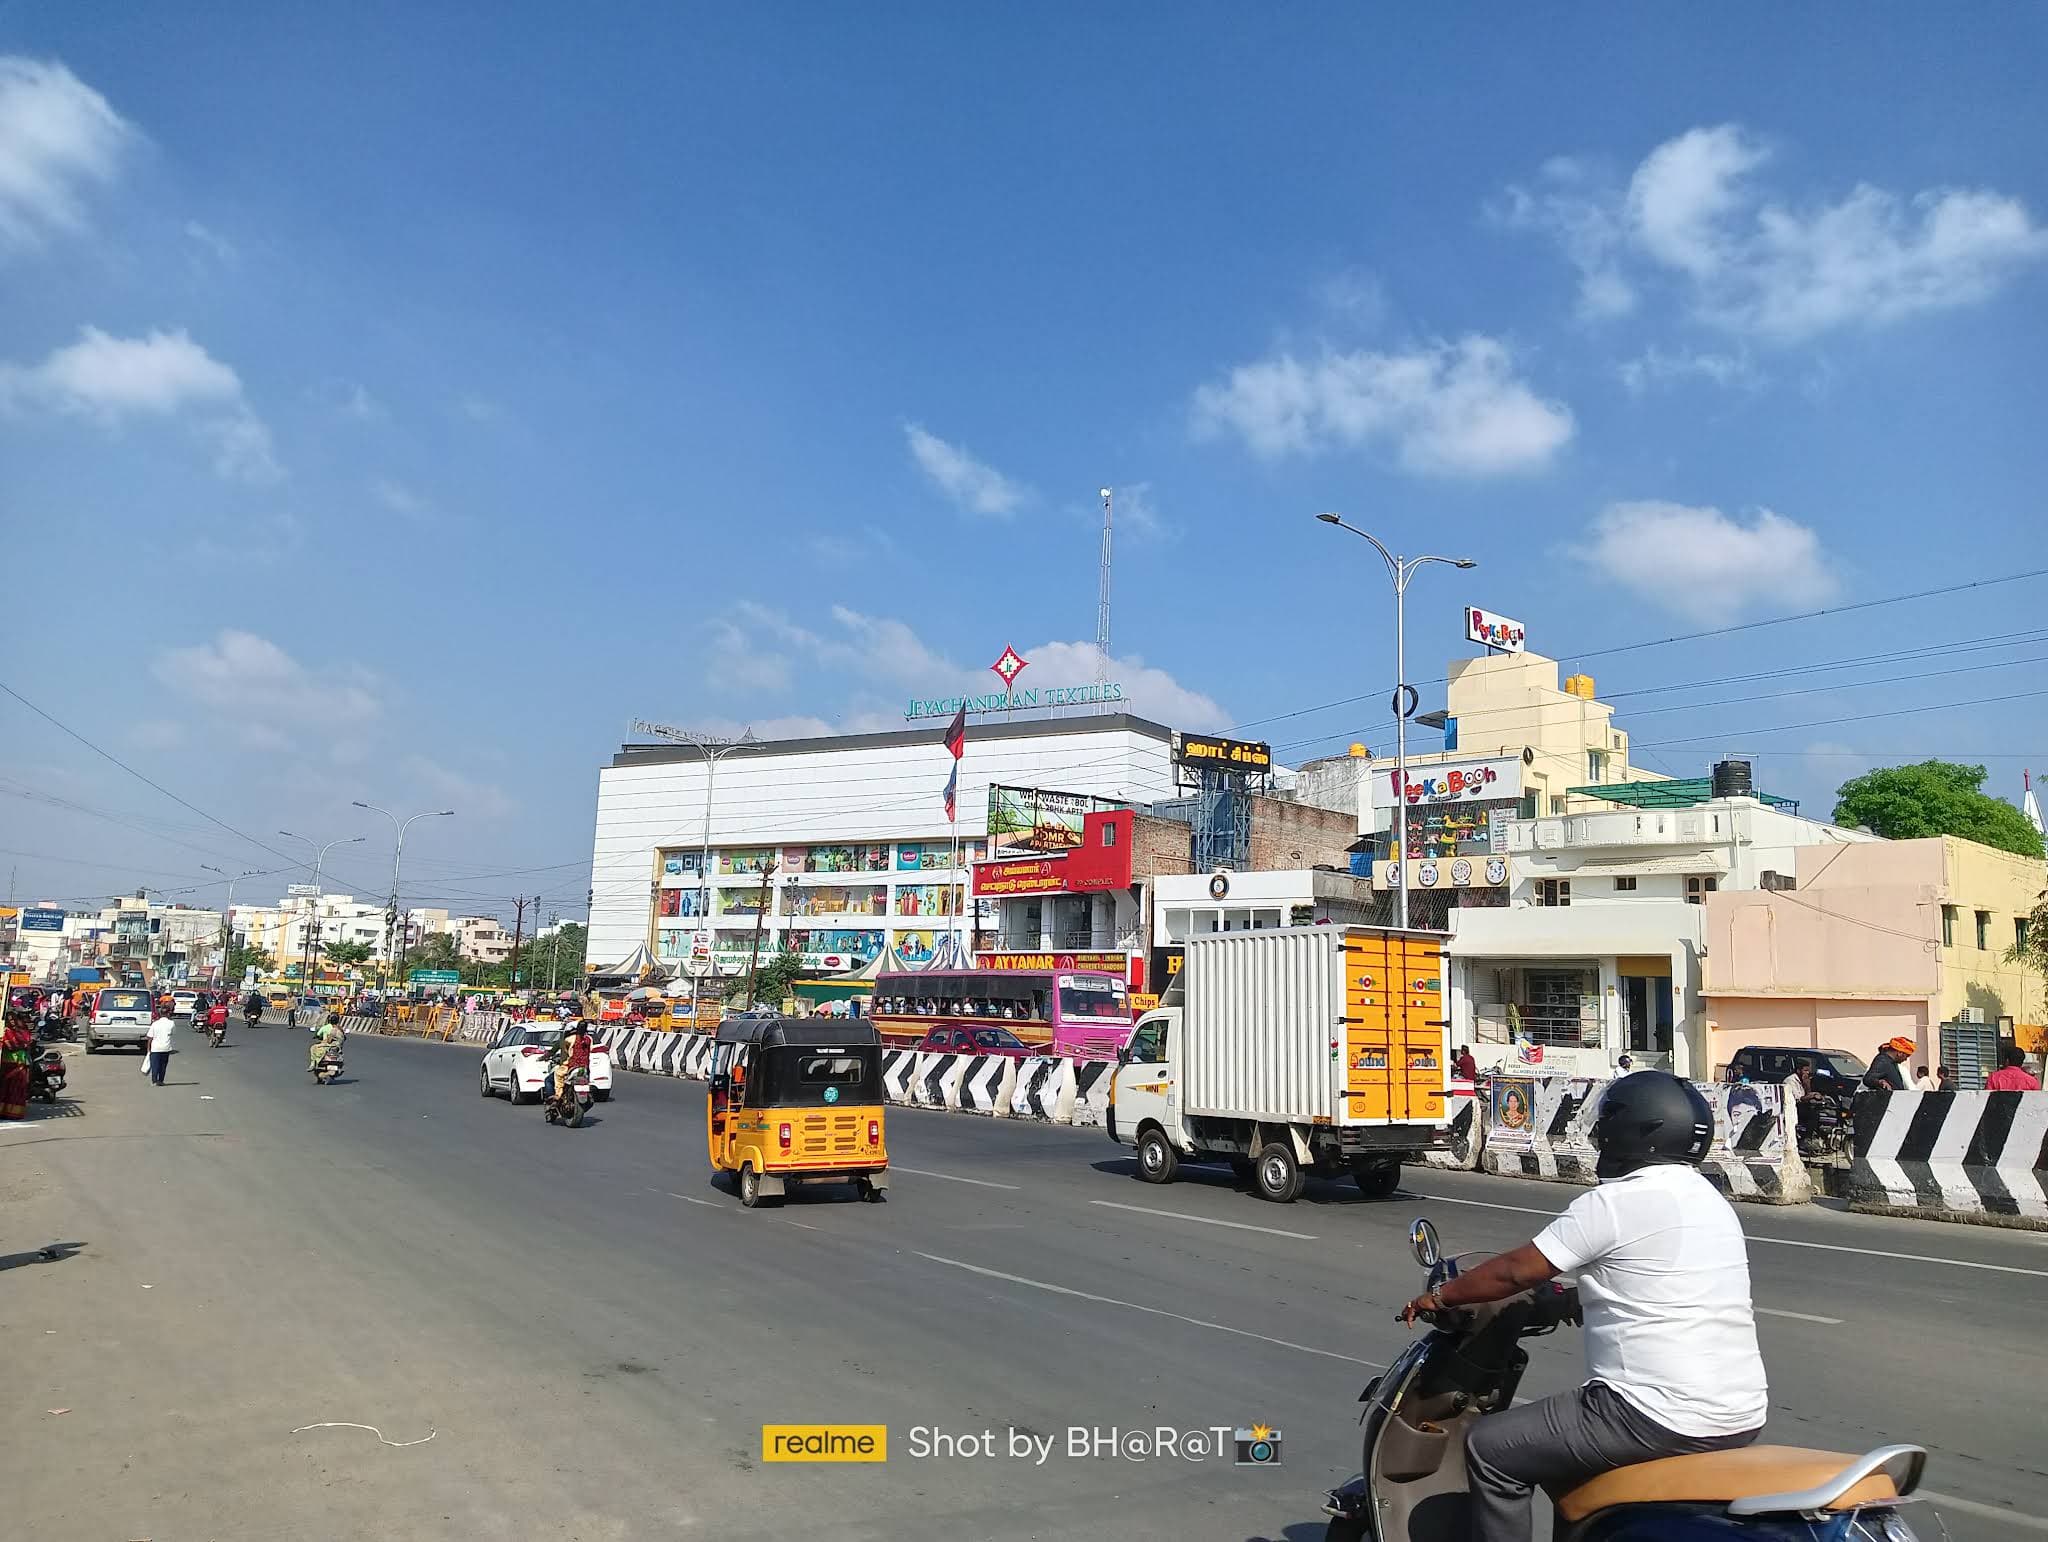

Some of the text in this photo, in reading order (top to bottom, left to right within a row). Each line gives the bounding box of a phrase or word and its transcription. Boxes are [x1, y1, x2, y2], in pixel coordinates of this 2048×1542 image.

[904, 683, 1122, 717] JEYACHANDRAN TEXTILES
[1185, 742, 1269, 766] ஹாட் சிப்ஸ்
[1019, 790, 1037, 801] WH
[1041, 793, 1068, 806] WASTE
[994, 954, 1055, 970] AYYANAR
[1134, 996, 1156, 1008] Chips
